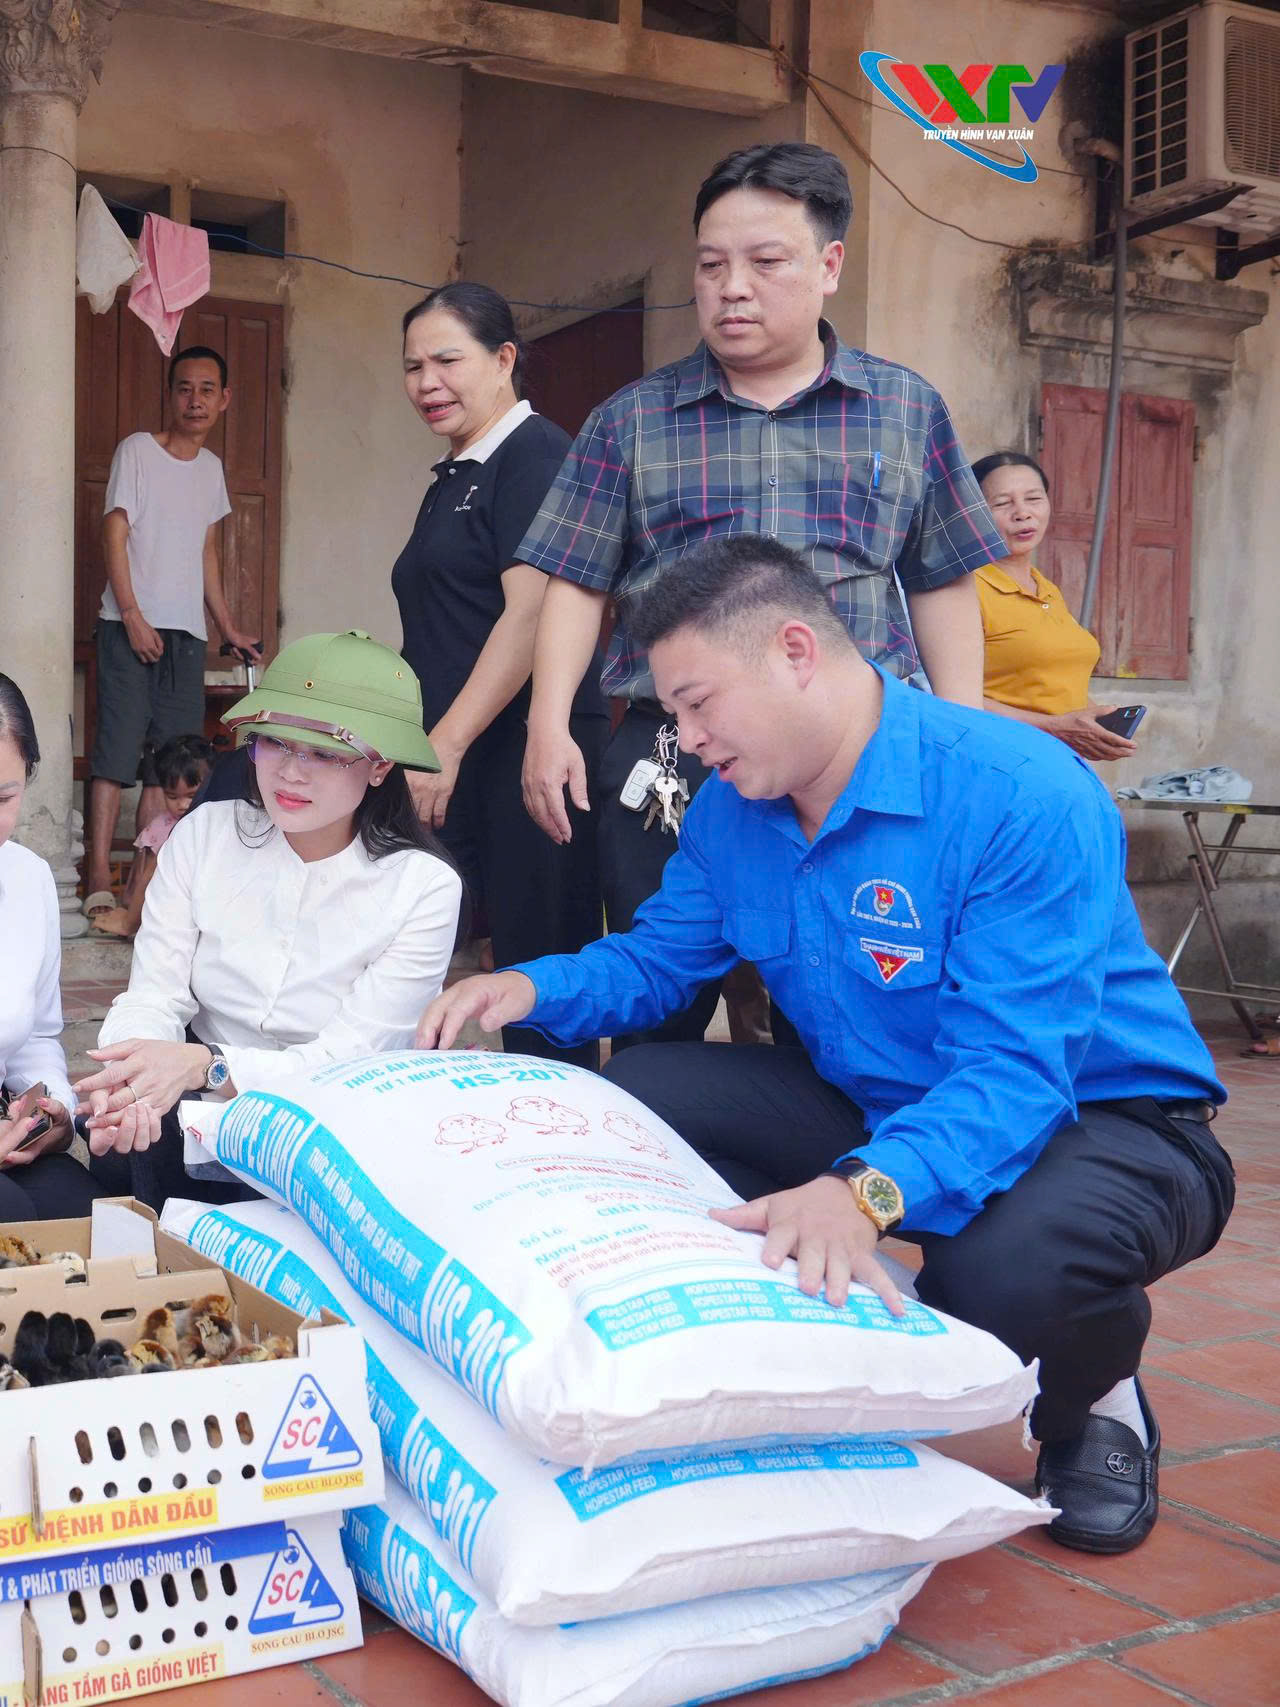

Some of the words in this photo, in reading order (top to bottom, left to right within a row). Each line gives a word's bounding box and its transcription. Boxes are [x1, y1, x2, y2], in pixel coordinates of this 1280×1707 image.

[448, 1069, 569, 1091] HS-201
[283, 1416, 322, 1450] SC
[671, 1462, 720, 1480] HOPESTAR
[719, 1460, 744, 1472] FEED
[836, 1454, 884, 1467] HOPESTAR
[882, 1453, 908, 1465] FEED
[264, 1484, 294, 1497] SONG
[296, 1481, 317, 1492] CAU
[584, 1485, 633, 1512] HOPESTAR
[632, 1476, 657, 1492] FEED
[34, 1514, 104, 1544] MỆNH
[112, 1500, 158, 1532] DẪN
[166, 1493, 213, 1522] ĐẦU
[8, 1580, 18, 1600] &
[21, 1567, 57, 1597] PHÁT
[60, 1556, 101, 1591] TRIỂN
[102, 1552, 144, 1584] GIỐNG
[148, 1550, 183, 1576] SÔNG
[186, 1541, 212, 1570] CẦU
[268, 1570, 304, 1606] SC
[252, 1640, 280, 1654] SONG
[282, 1635, 302, 1646] CAU
[326, 1626, 344, 1640] JSC
[73, 1672, 106, 1700] TẦM
[111, 1667, 132, 1692] GÀ
[136, 1658, 183, 1688] GIỐNG
[188, 1652, 218, 1678] VIỆT
